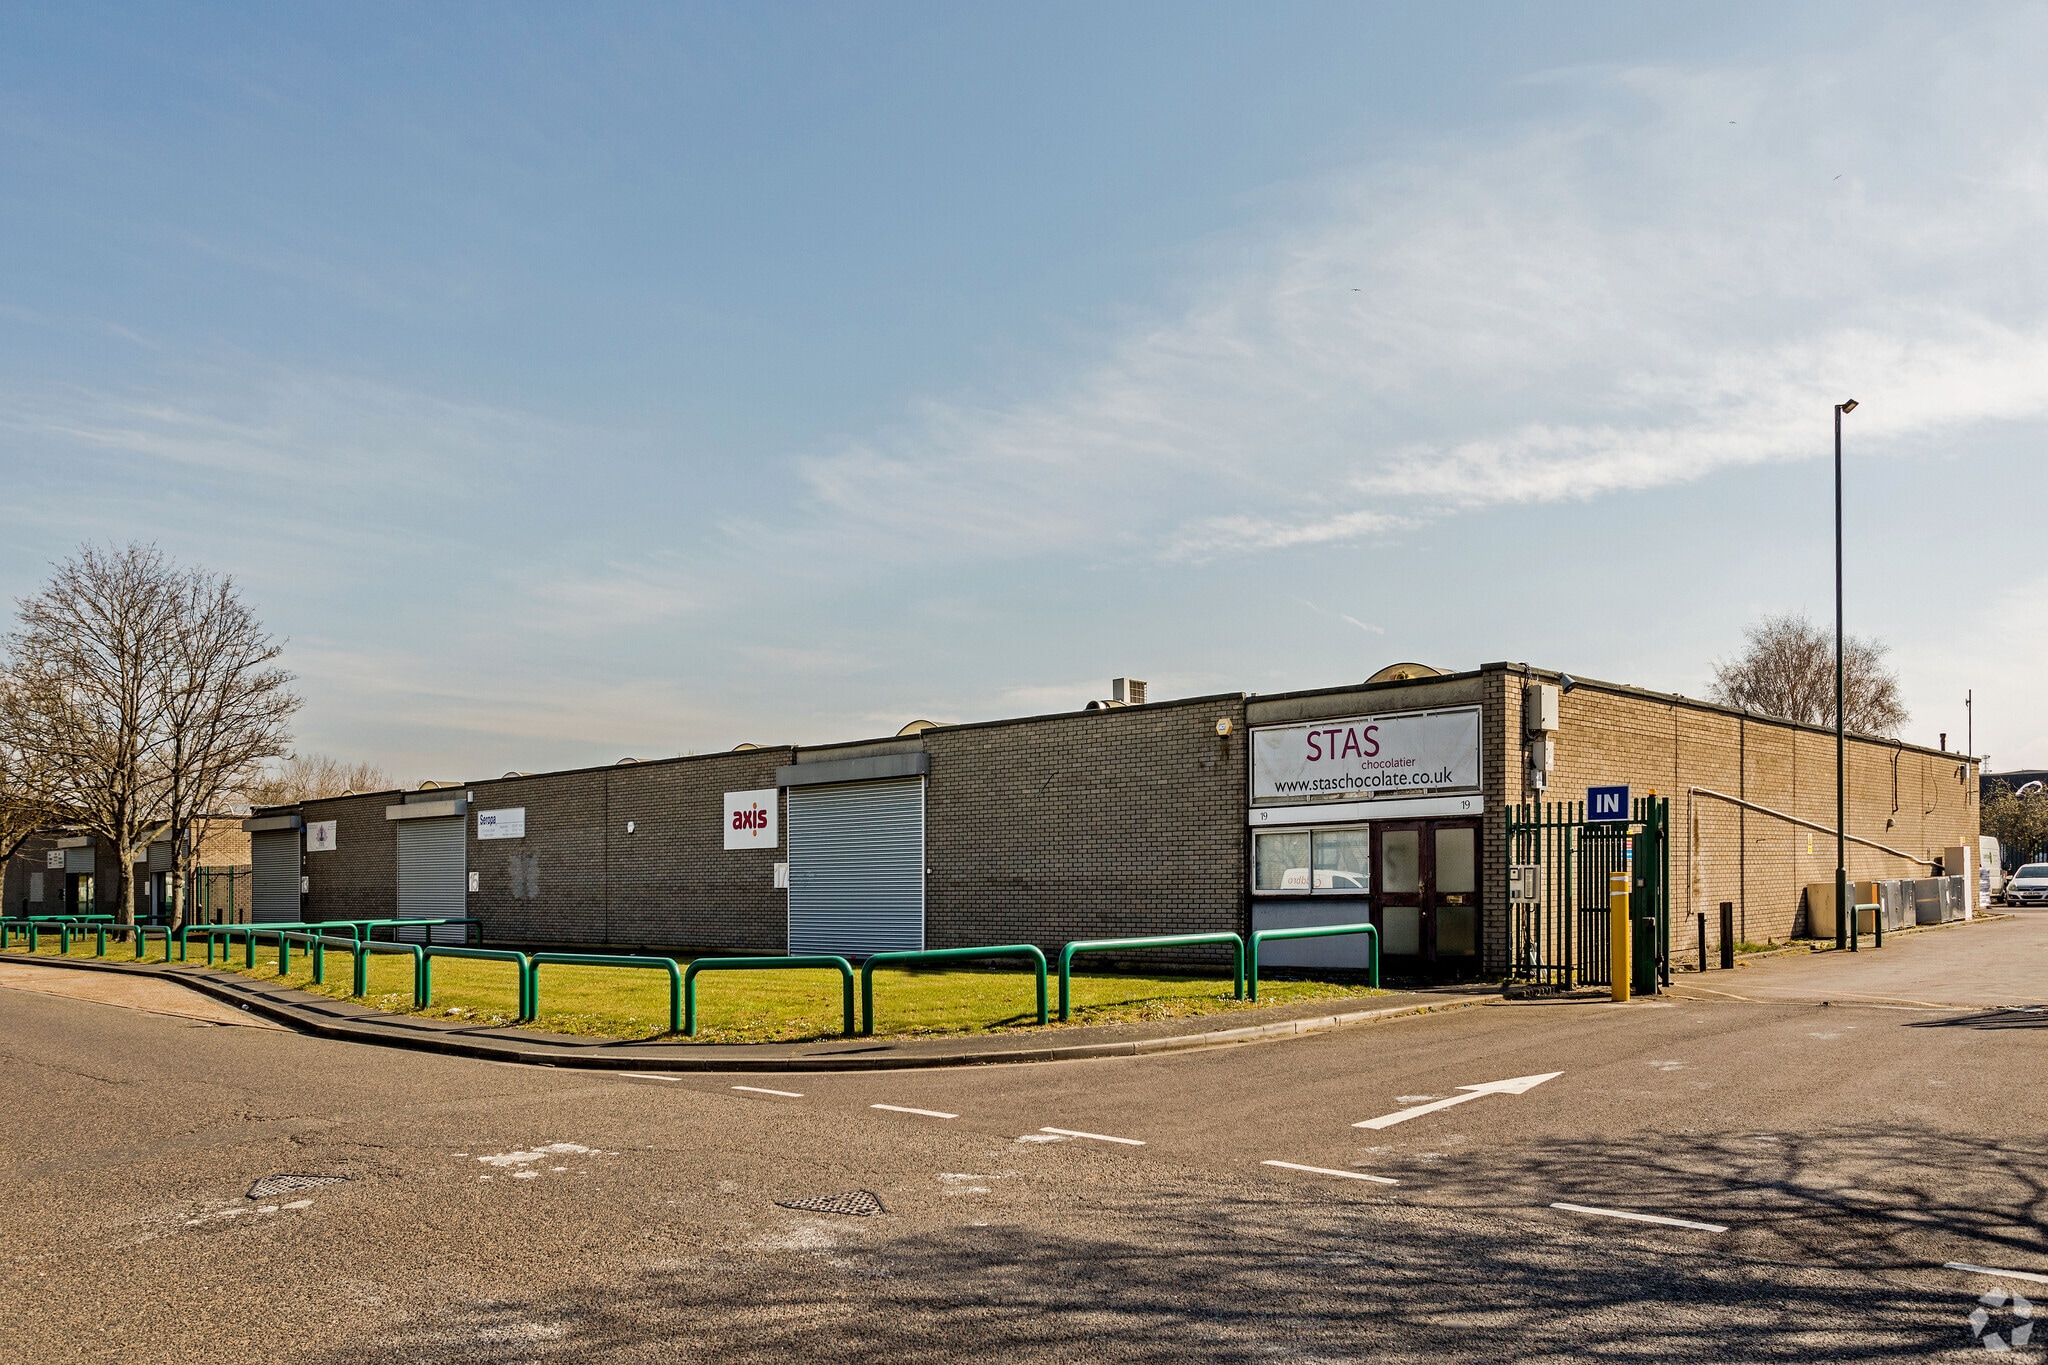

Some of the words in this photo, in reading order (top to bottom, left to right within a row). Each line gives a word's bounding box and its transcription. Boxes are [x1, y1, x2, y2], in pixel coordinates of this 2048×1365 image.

[1306, 725, 1379, 762] STAS
[1361, 757, 1416, 770] chocolatier
[1274, 766, 1453, 792] www.staschocolate.co.uk
[1460, 800, 1471, 810] 19
[1596, 793, 1619, 813] IN
[732, 802, 768, 837] axis
[1260, 811, 1268, 821] 19
